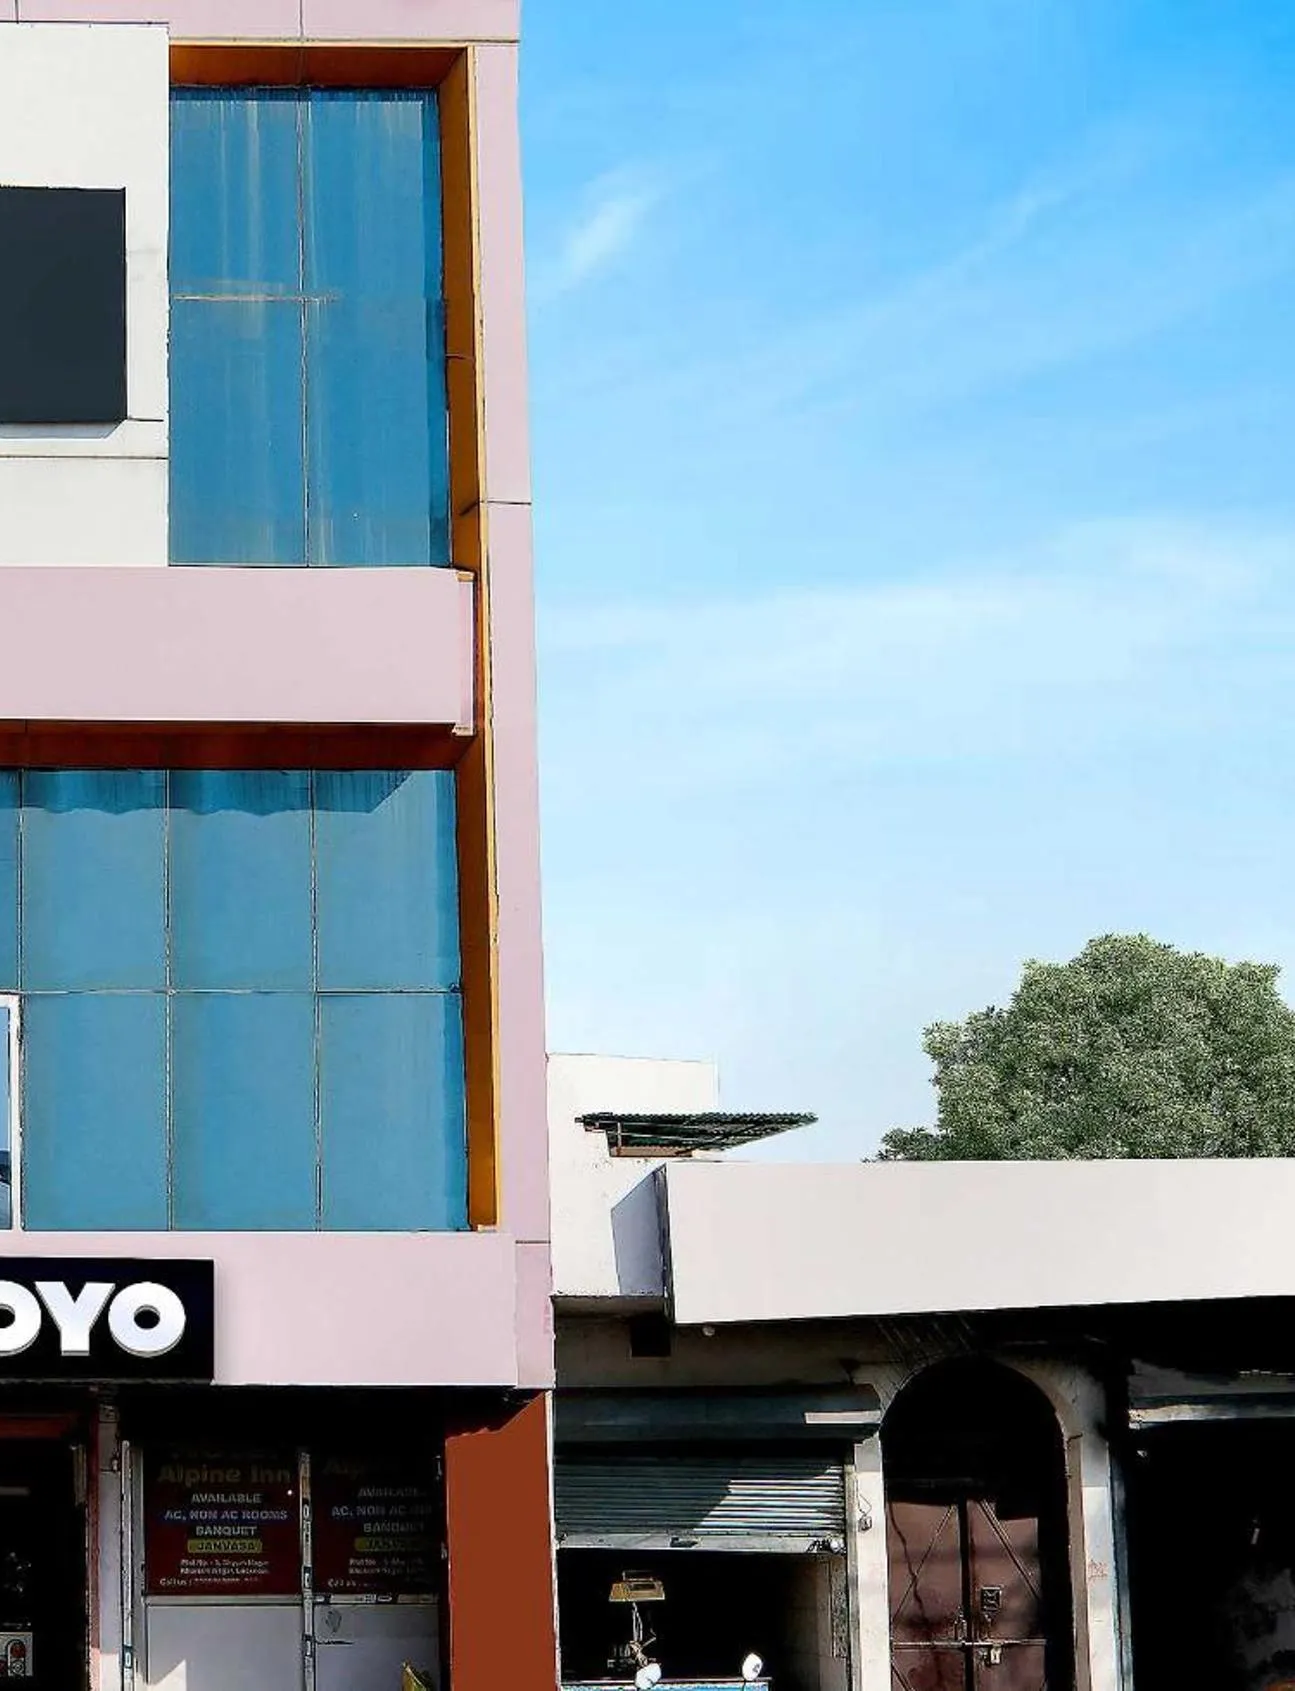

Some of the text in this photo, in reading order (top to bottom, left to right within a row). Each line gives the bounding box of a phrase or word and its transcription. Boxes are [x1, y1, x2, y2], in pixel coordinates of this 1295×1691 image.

[157, 1463, 292, 1488] Alpine Inn
[191, 1492, 263, 1504] AVAILABLE
[220, 1509, 239, 1520] AC
[241, 1509, 288, 1520] ROOMS
[195, 1525, 258, 1536] BANQUET
